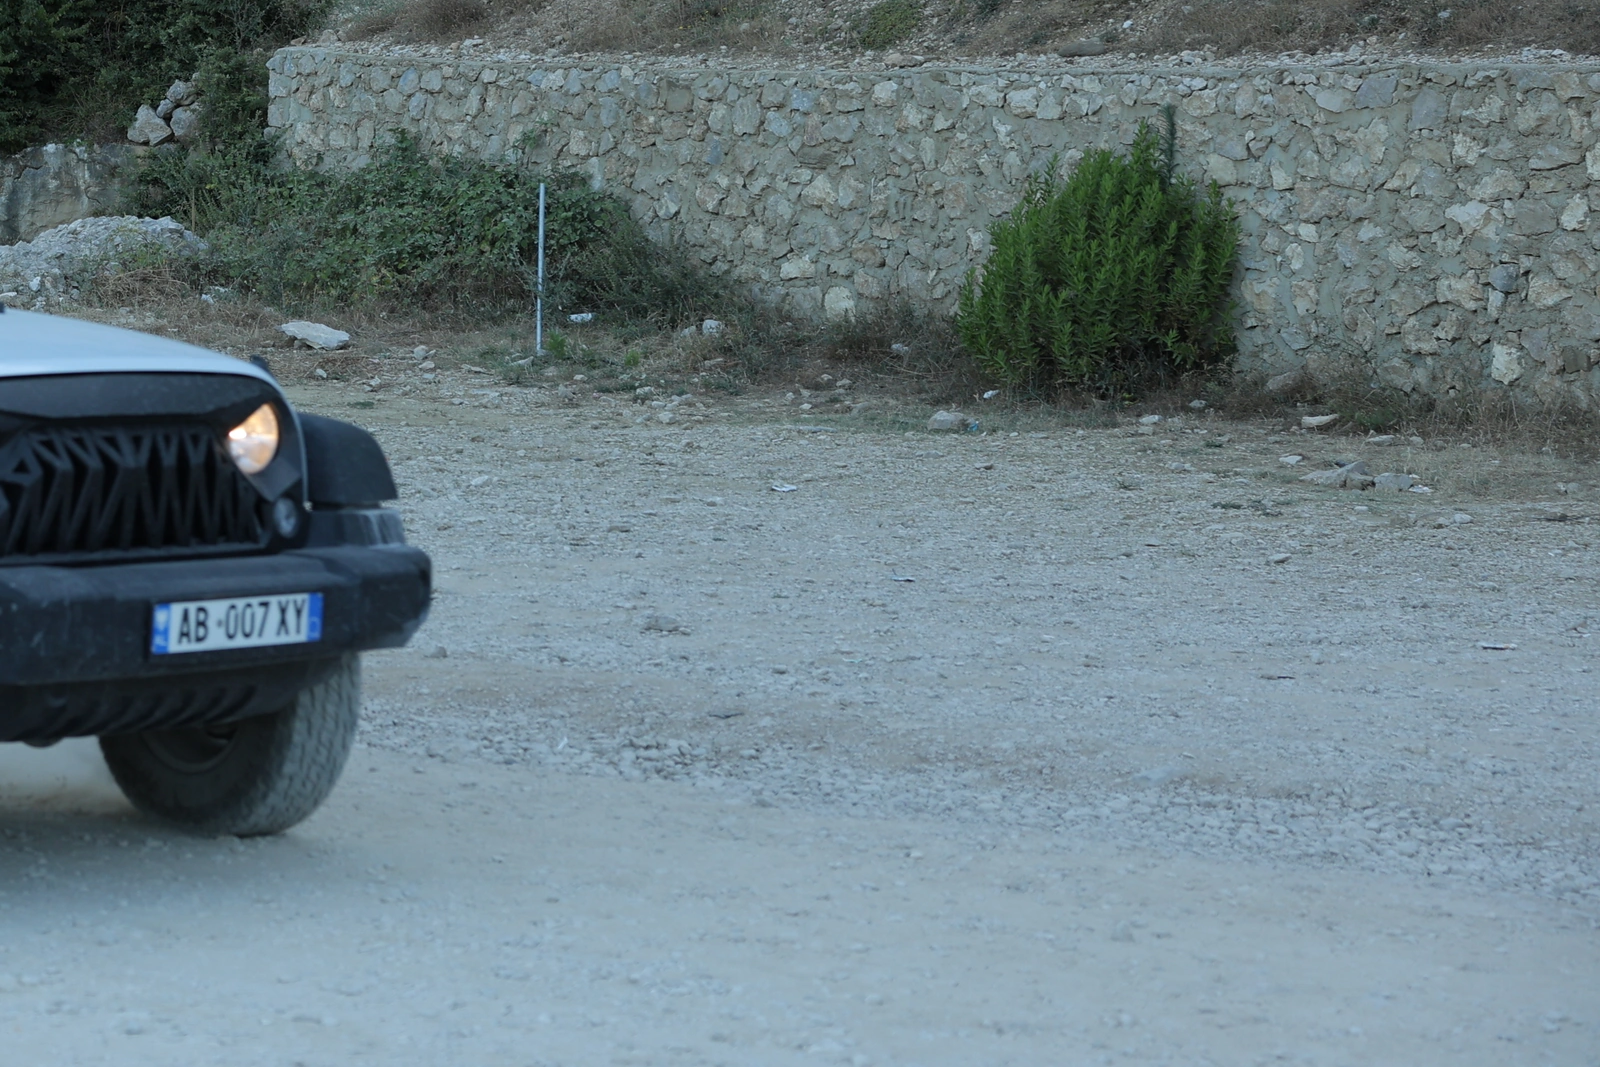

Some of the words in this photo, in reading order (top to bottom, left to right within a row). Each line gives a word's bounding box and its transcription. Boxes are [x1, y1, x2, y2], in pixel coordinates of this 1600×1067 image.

[177, 606, 209, 645] AB
[224, 601, 270, 640] 007
[276, 598, 306, 637] XY
